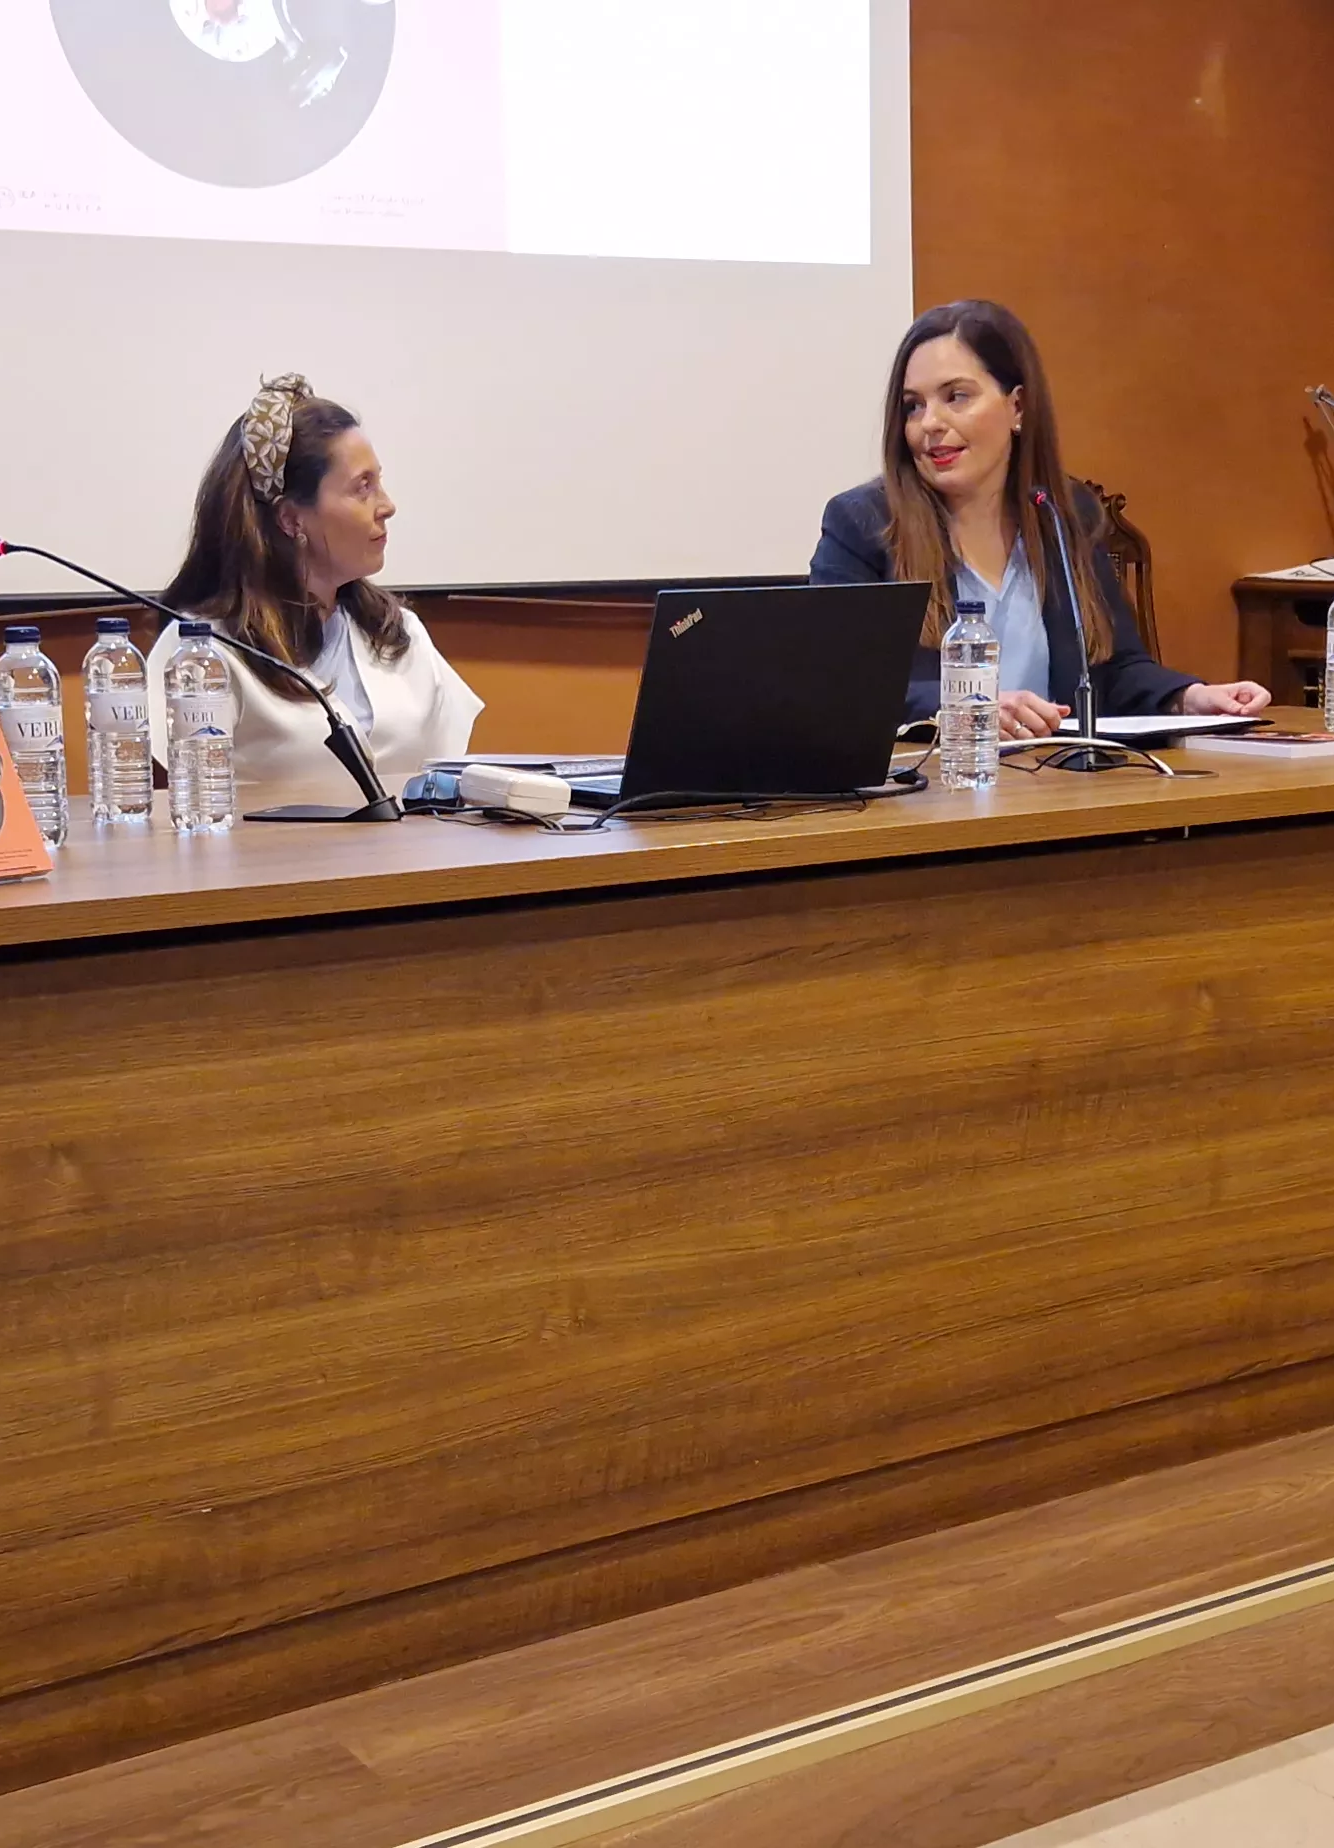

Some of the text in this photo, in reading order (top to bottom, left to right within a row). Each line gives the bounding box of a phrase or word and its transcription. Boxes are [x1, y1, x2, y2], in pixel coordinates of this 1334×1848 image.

[669, 607, 703, 639] ThinkPad
[112, 705, 148, 721] VERI
[183, 711, 216, 723] VERI
[17, 721, 59, 739] VERI
